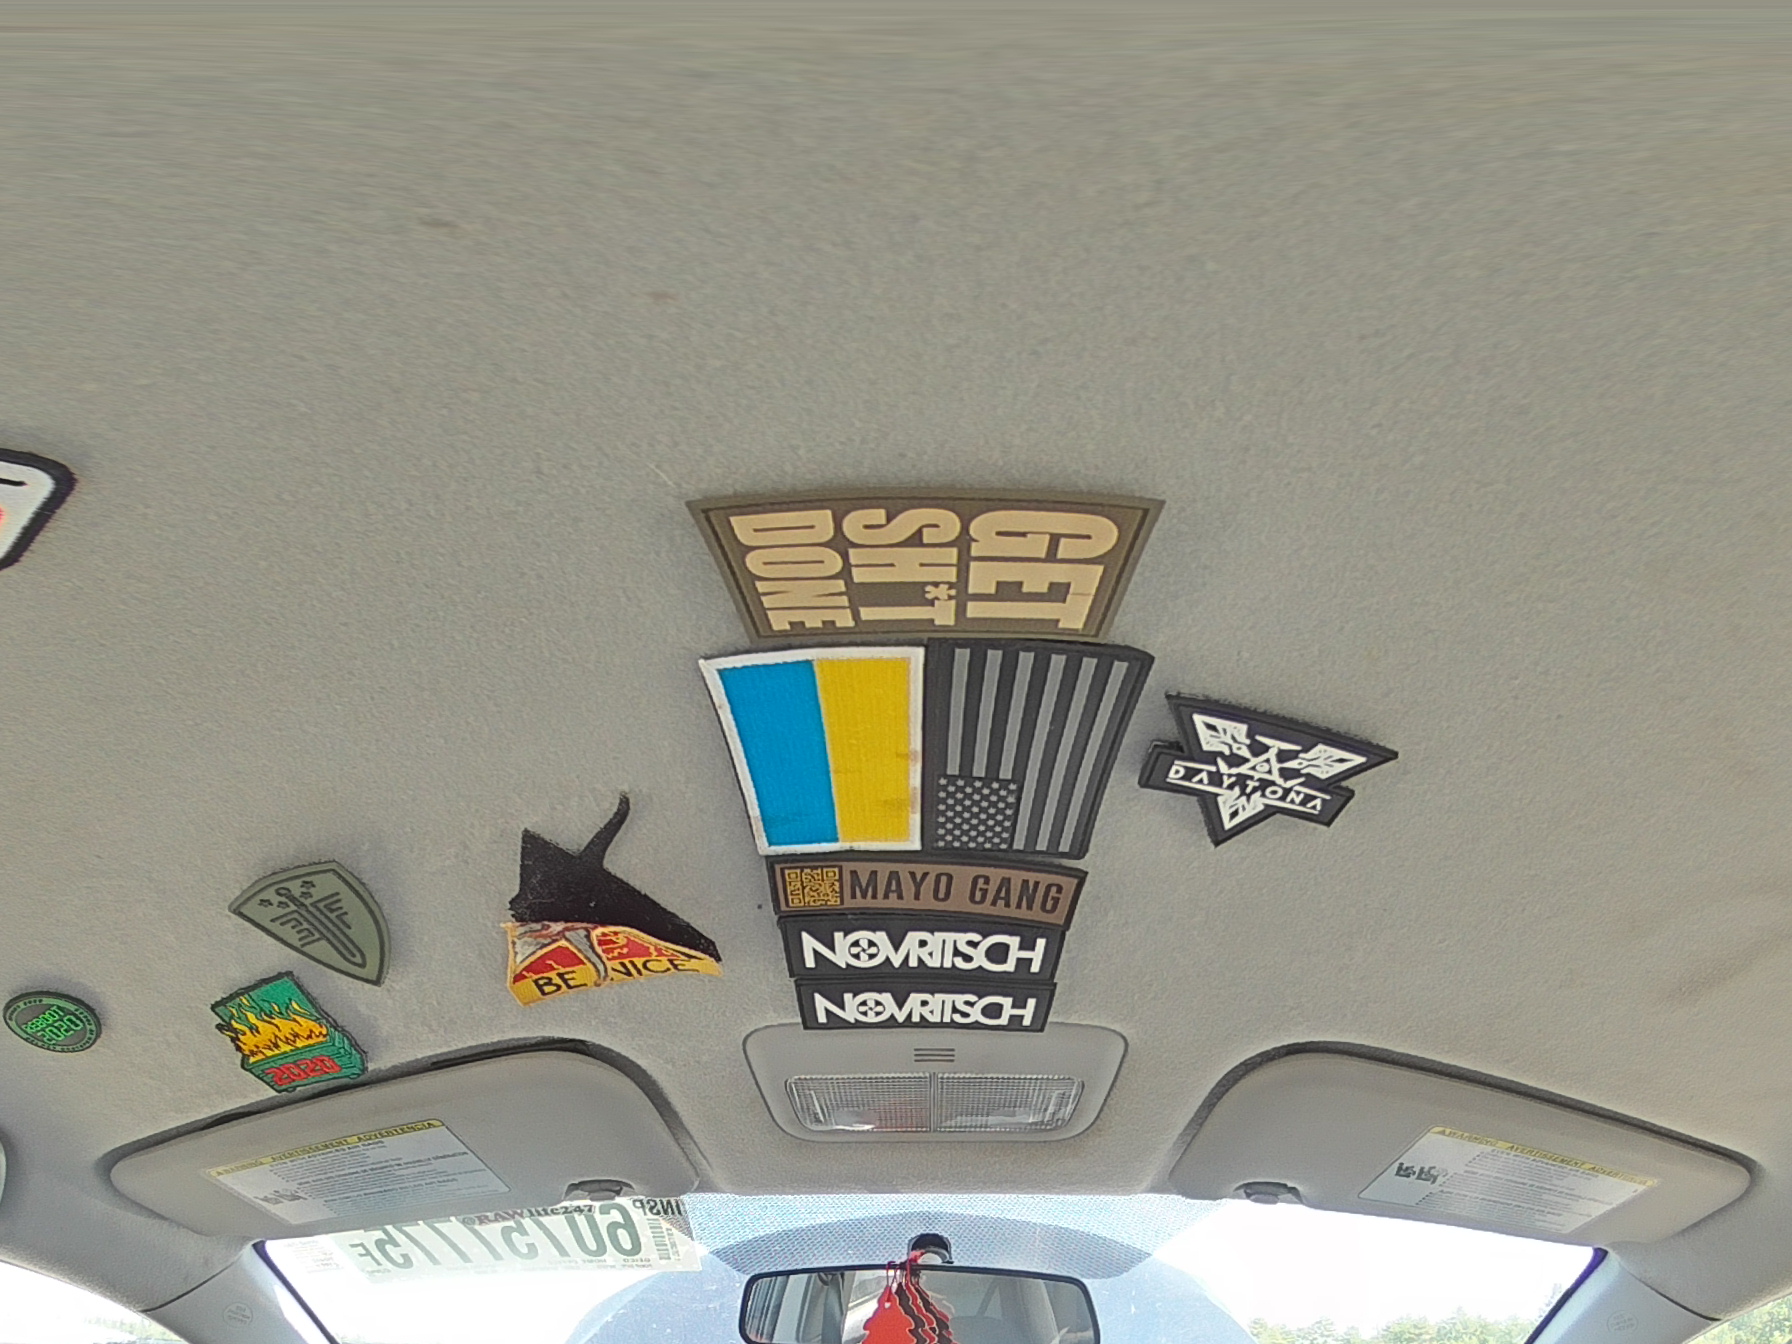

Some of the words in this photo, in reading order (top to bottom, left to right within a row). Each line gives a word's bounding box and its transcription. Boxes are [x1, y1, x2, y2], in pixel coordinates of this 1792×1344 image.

[728, 508, 856, 632] DONE
[965, 508, 1119, 632] GET
[1167, 764, 1324, 813] DAYTONA
[848, 867, 955, 903] MAYO
[968, 872, 1066, 916] GANG
[800, 929, 1047, 975] NOVRITSCH
[531, 968, 588, 998] BE
[610, 957, 701, 983] NICE
[36, 1014, 85, 1046] 2020
[813, 991, 1038, 1028] NOVRITSCH
[264, 1054, 343, 1087] 2020
[270, 1138, 350, 1163] AVERTISSEMENT
[356, 1121, 437, 1144] ADVERTENCIA
